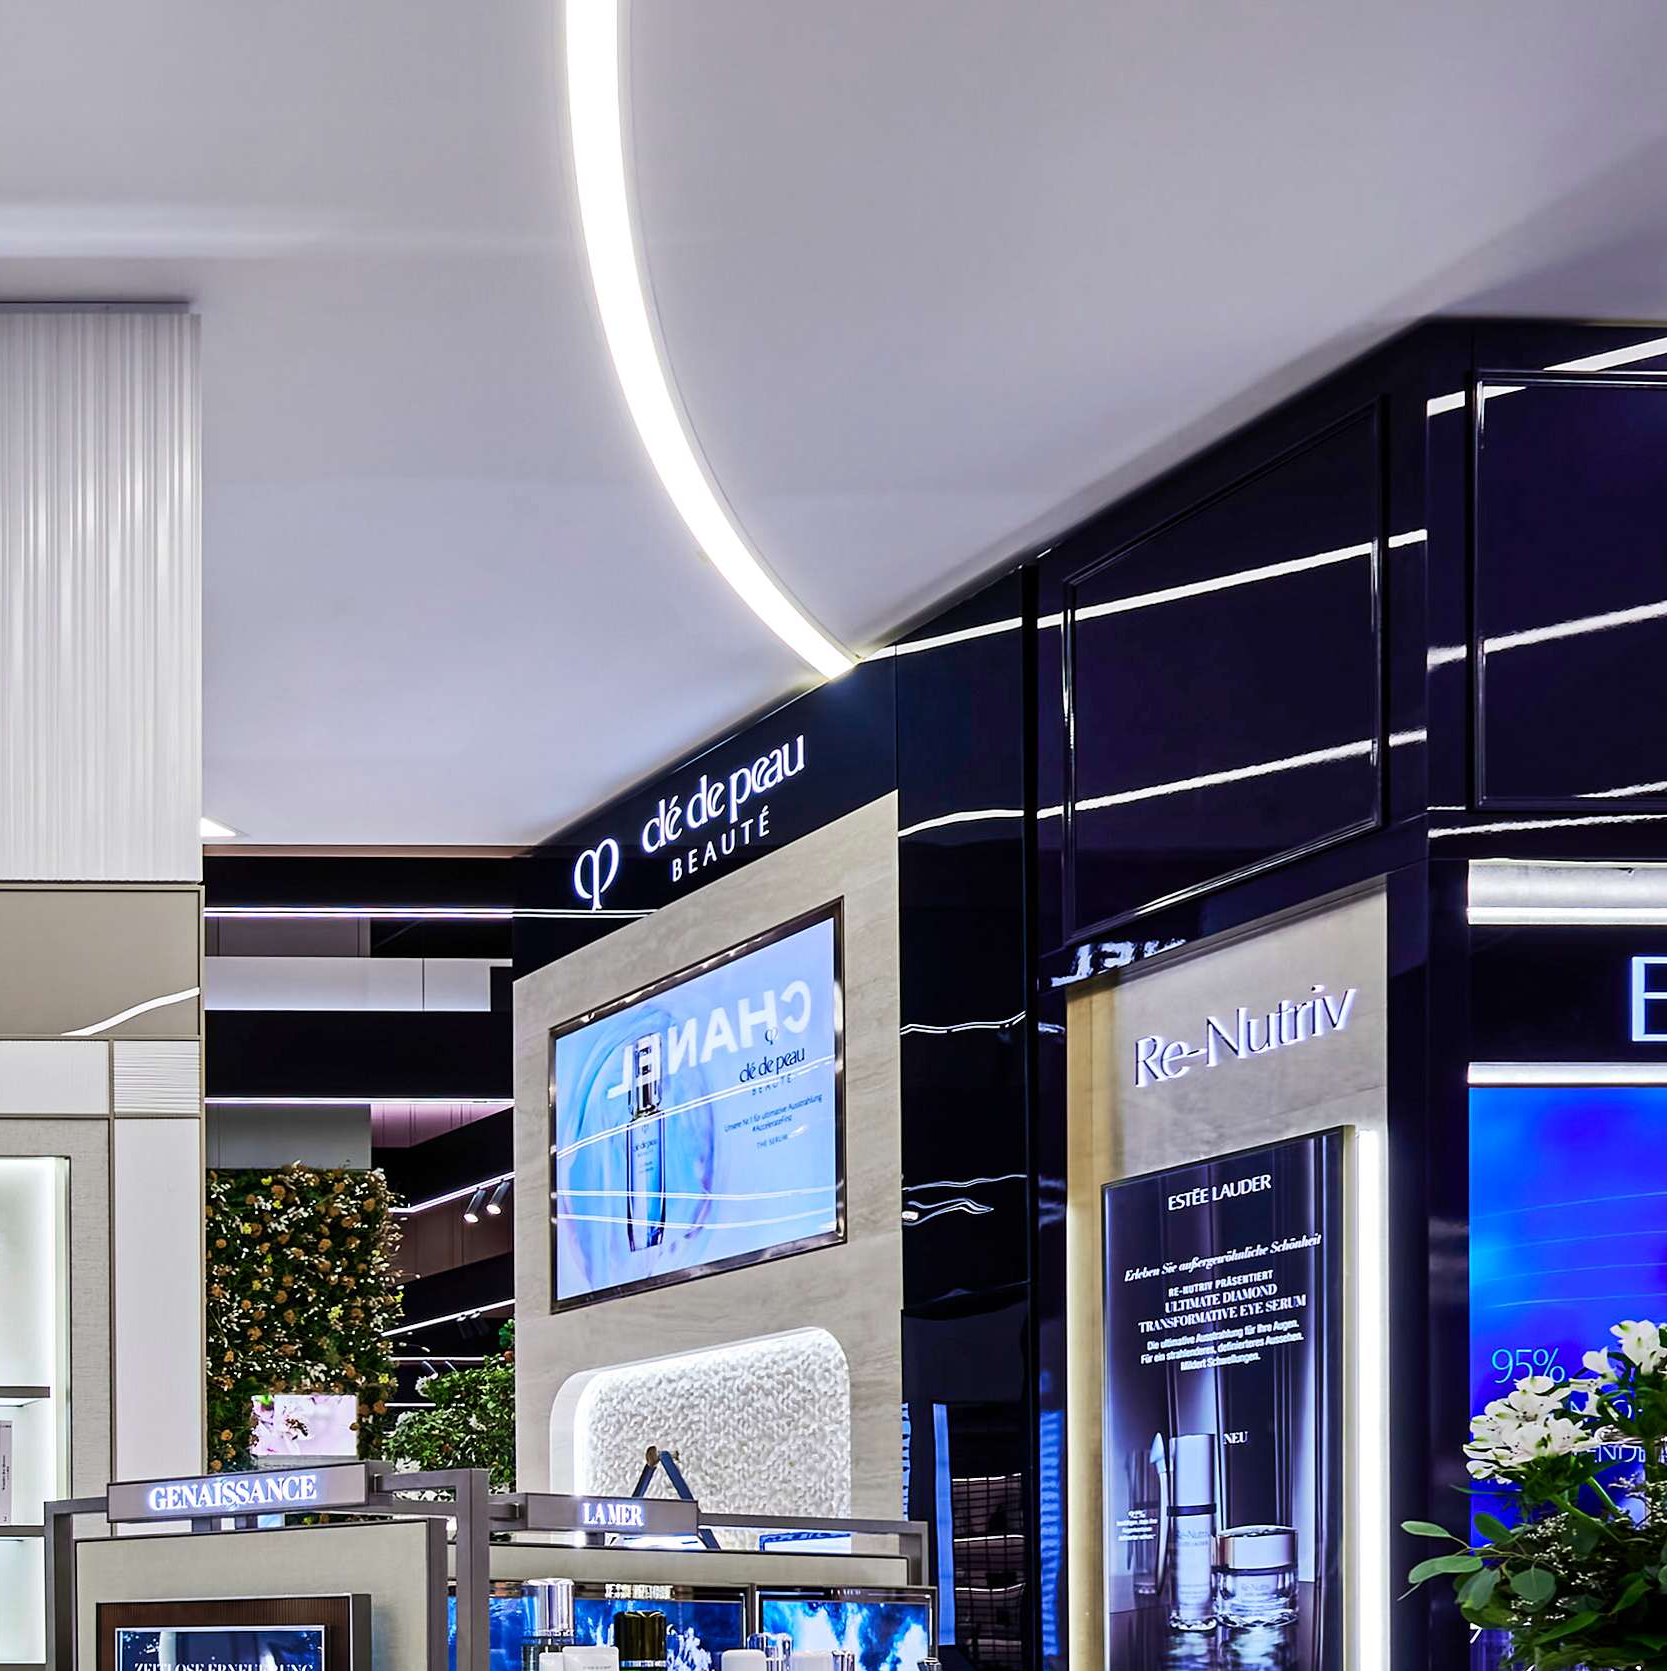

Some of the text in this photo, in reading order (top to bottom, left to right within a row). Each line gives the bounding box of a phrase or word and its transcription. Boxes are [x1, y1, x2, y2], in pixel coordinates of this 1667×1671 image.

[642, 734, 805, 854] clé de peau
[671, 804, 770, 883] BEAUTÉ
[1135, 983, 1358, 1088] Re-Nutriv
[758, 1056, 774, 1076] de
[775, 1047, 805, 1075] peau
[1211, 1173, 1273, 1202] LAUDER
[1124, 1232, 1322, 1283] Erleben Sie außergewöhnliche Schönheit
[1214, 1268, 1275, 1291] PRÄSENTIERT
[1137, 1293, 1307, 1334] TRANSFORMATIVE EYE SERUM
[1164, 1282, 1278, 1314] ULTIMATE DIAMOND
[1140, 1353, 1154, 1365] Für
[1491, 1348, 1566, 1384] 95%
[1223, 1430, 1249, 1446] NEU
[148, 1474, 317, 1512] GENAISSANCE
[582, 1502, 644, 1527] LA MER
